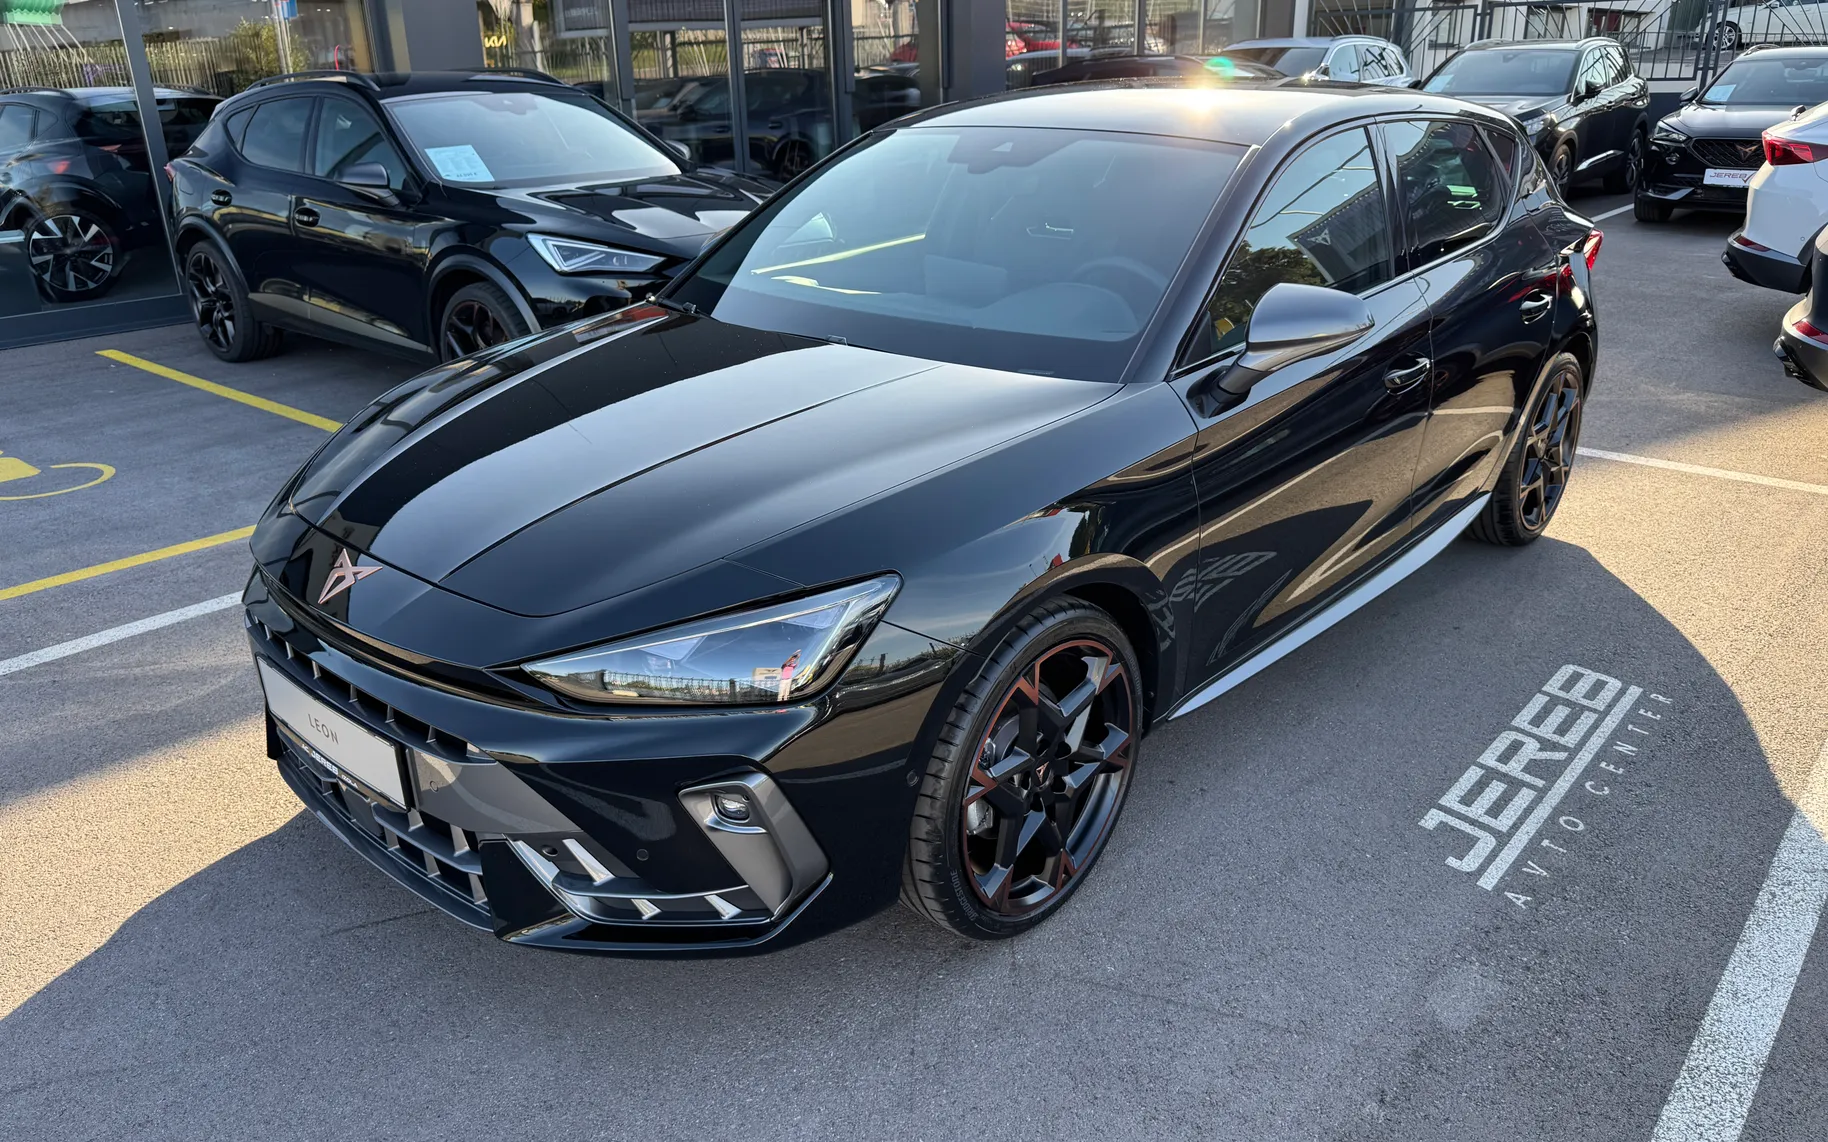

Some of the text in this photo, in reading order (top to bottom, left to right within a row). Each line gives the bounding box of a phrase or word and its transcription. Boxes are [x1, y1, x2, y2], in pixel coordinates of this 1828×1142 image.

[308, 713, 339, 744] LEON
[311, 750, 339, 775] JEREB
[1418, 664, 1622, 872] JEREB
[1504, 693, 1673, 909] AVTO CENTER
[950, 869, 979, 921] BRIDGESTONE
